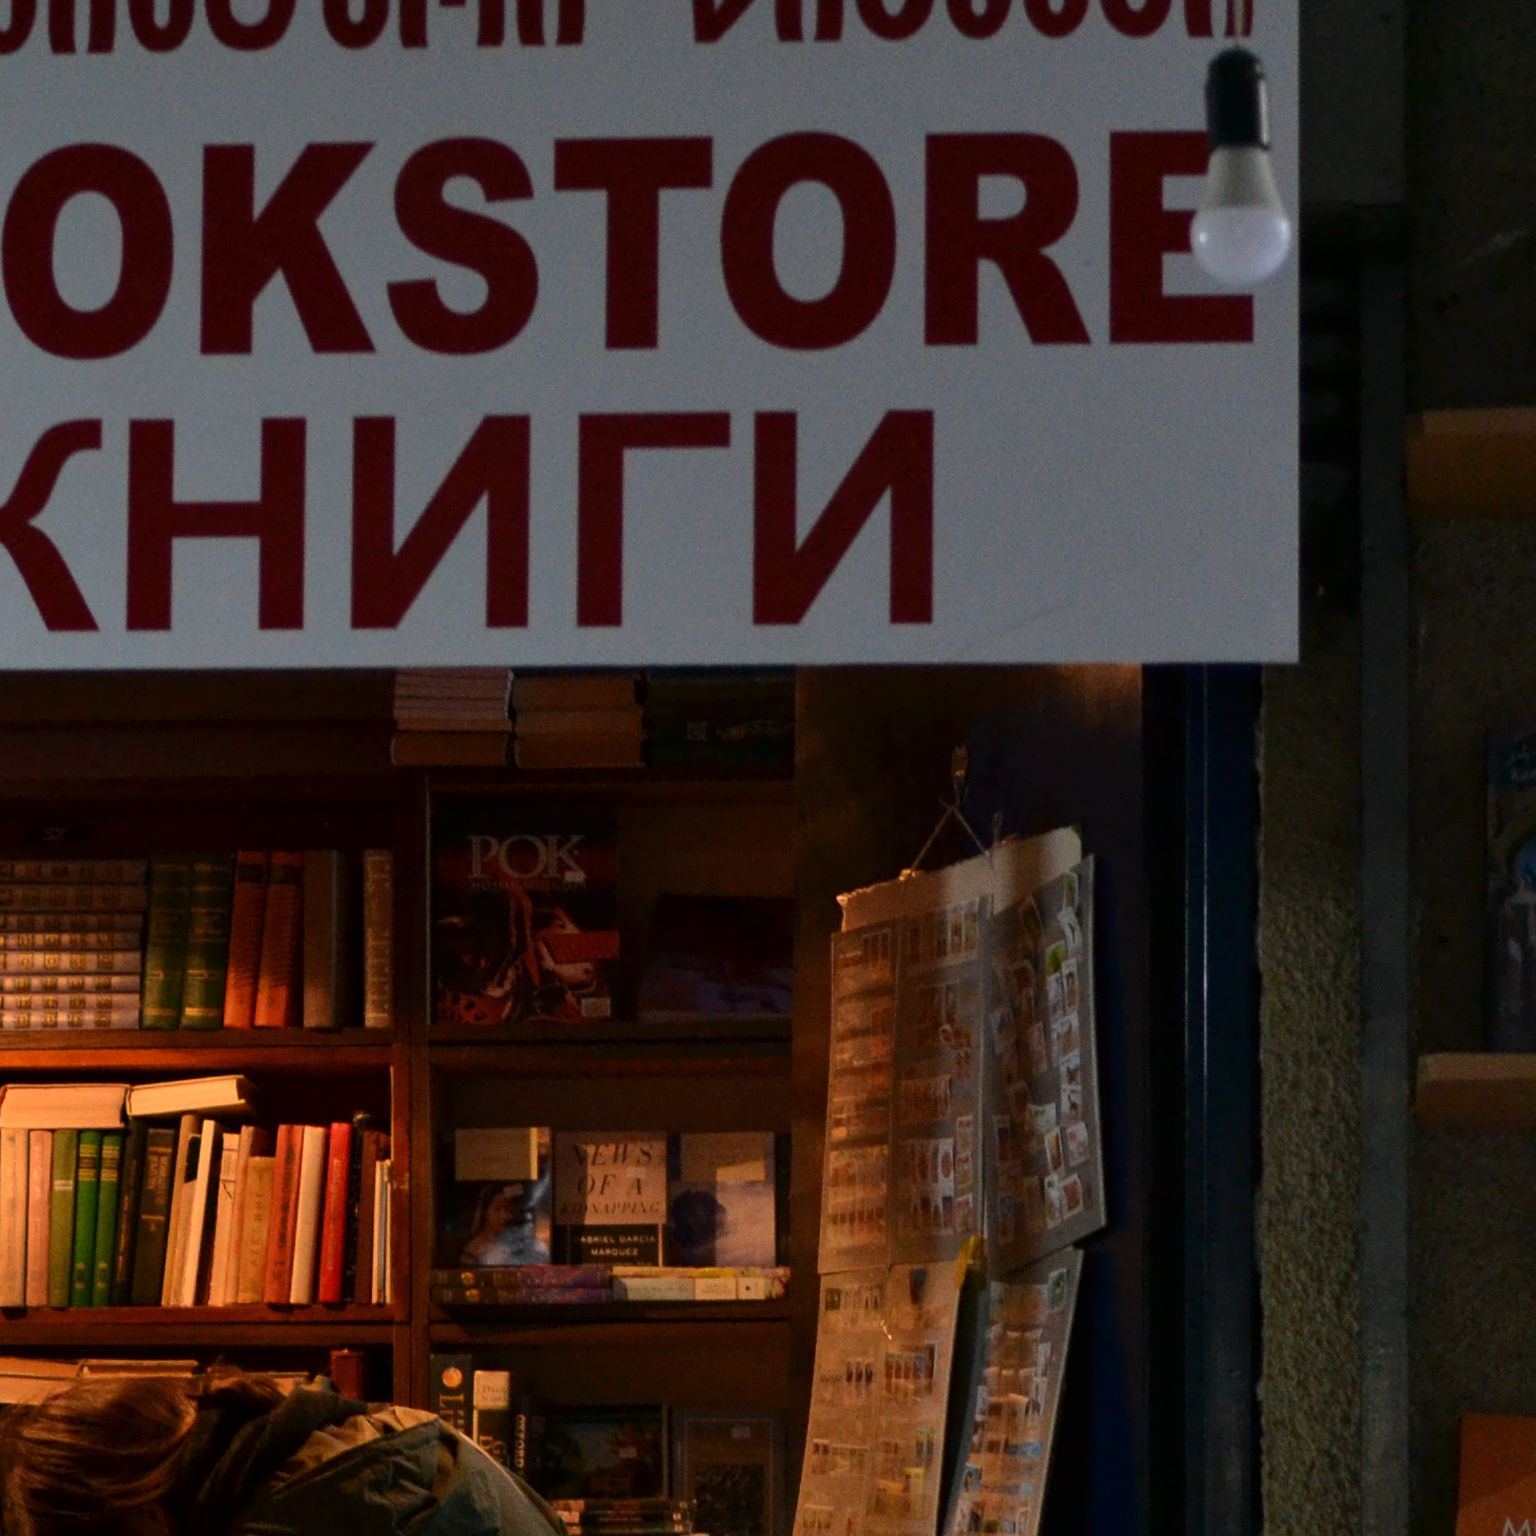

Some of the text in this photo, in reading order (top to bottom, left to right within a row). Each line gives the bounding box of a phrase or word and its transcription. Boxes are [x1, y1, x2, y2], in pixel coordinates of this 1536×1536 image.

[572, 1142, 653, 1168] NEWS
[577, 1172, 646, 1197] OF A
